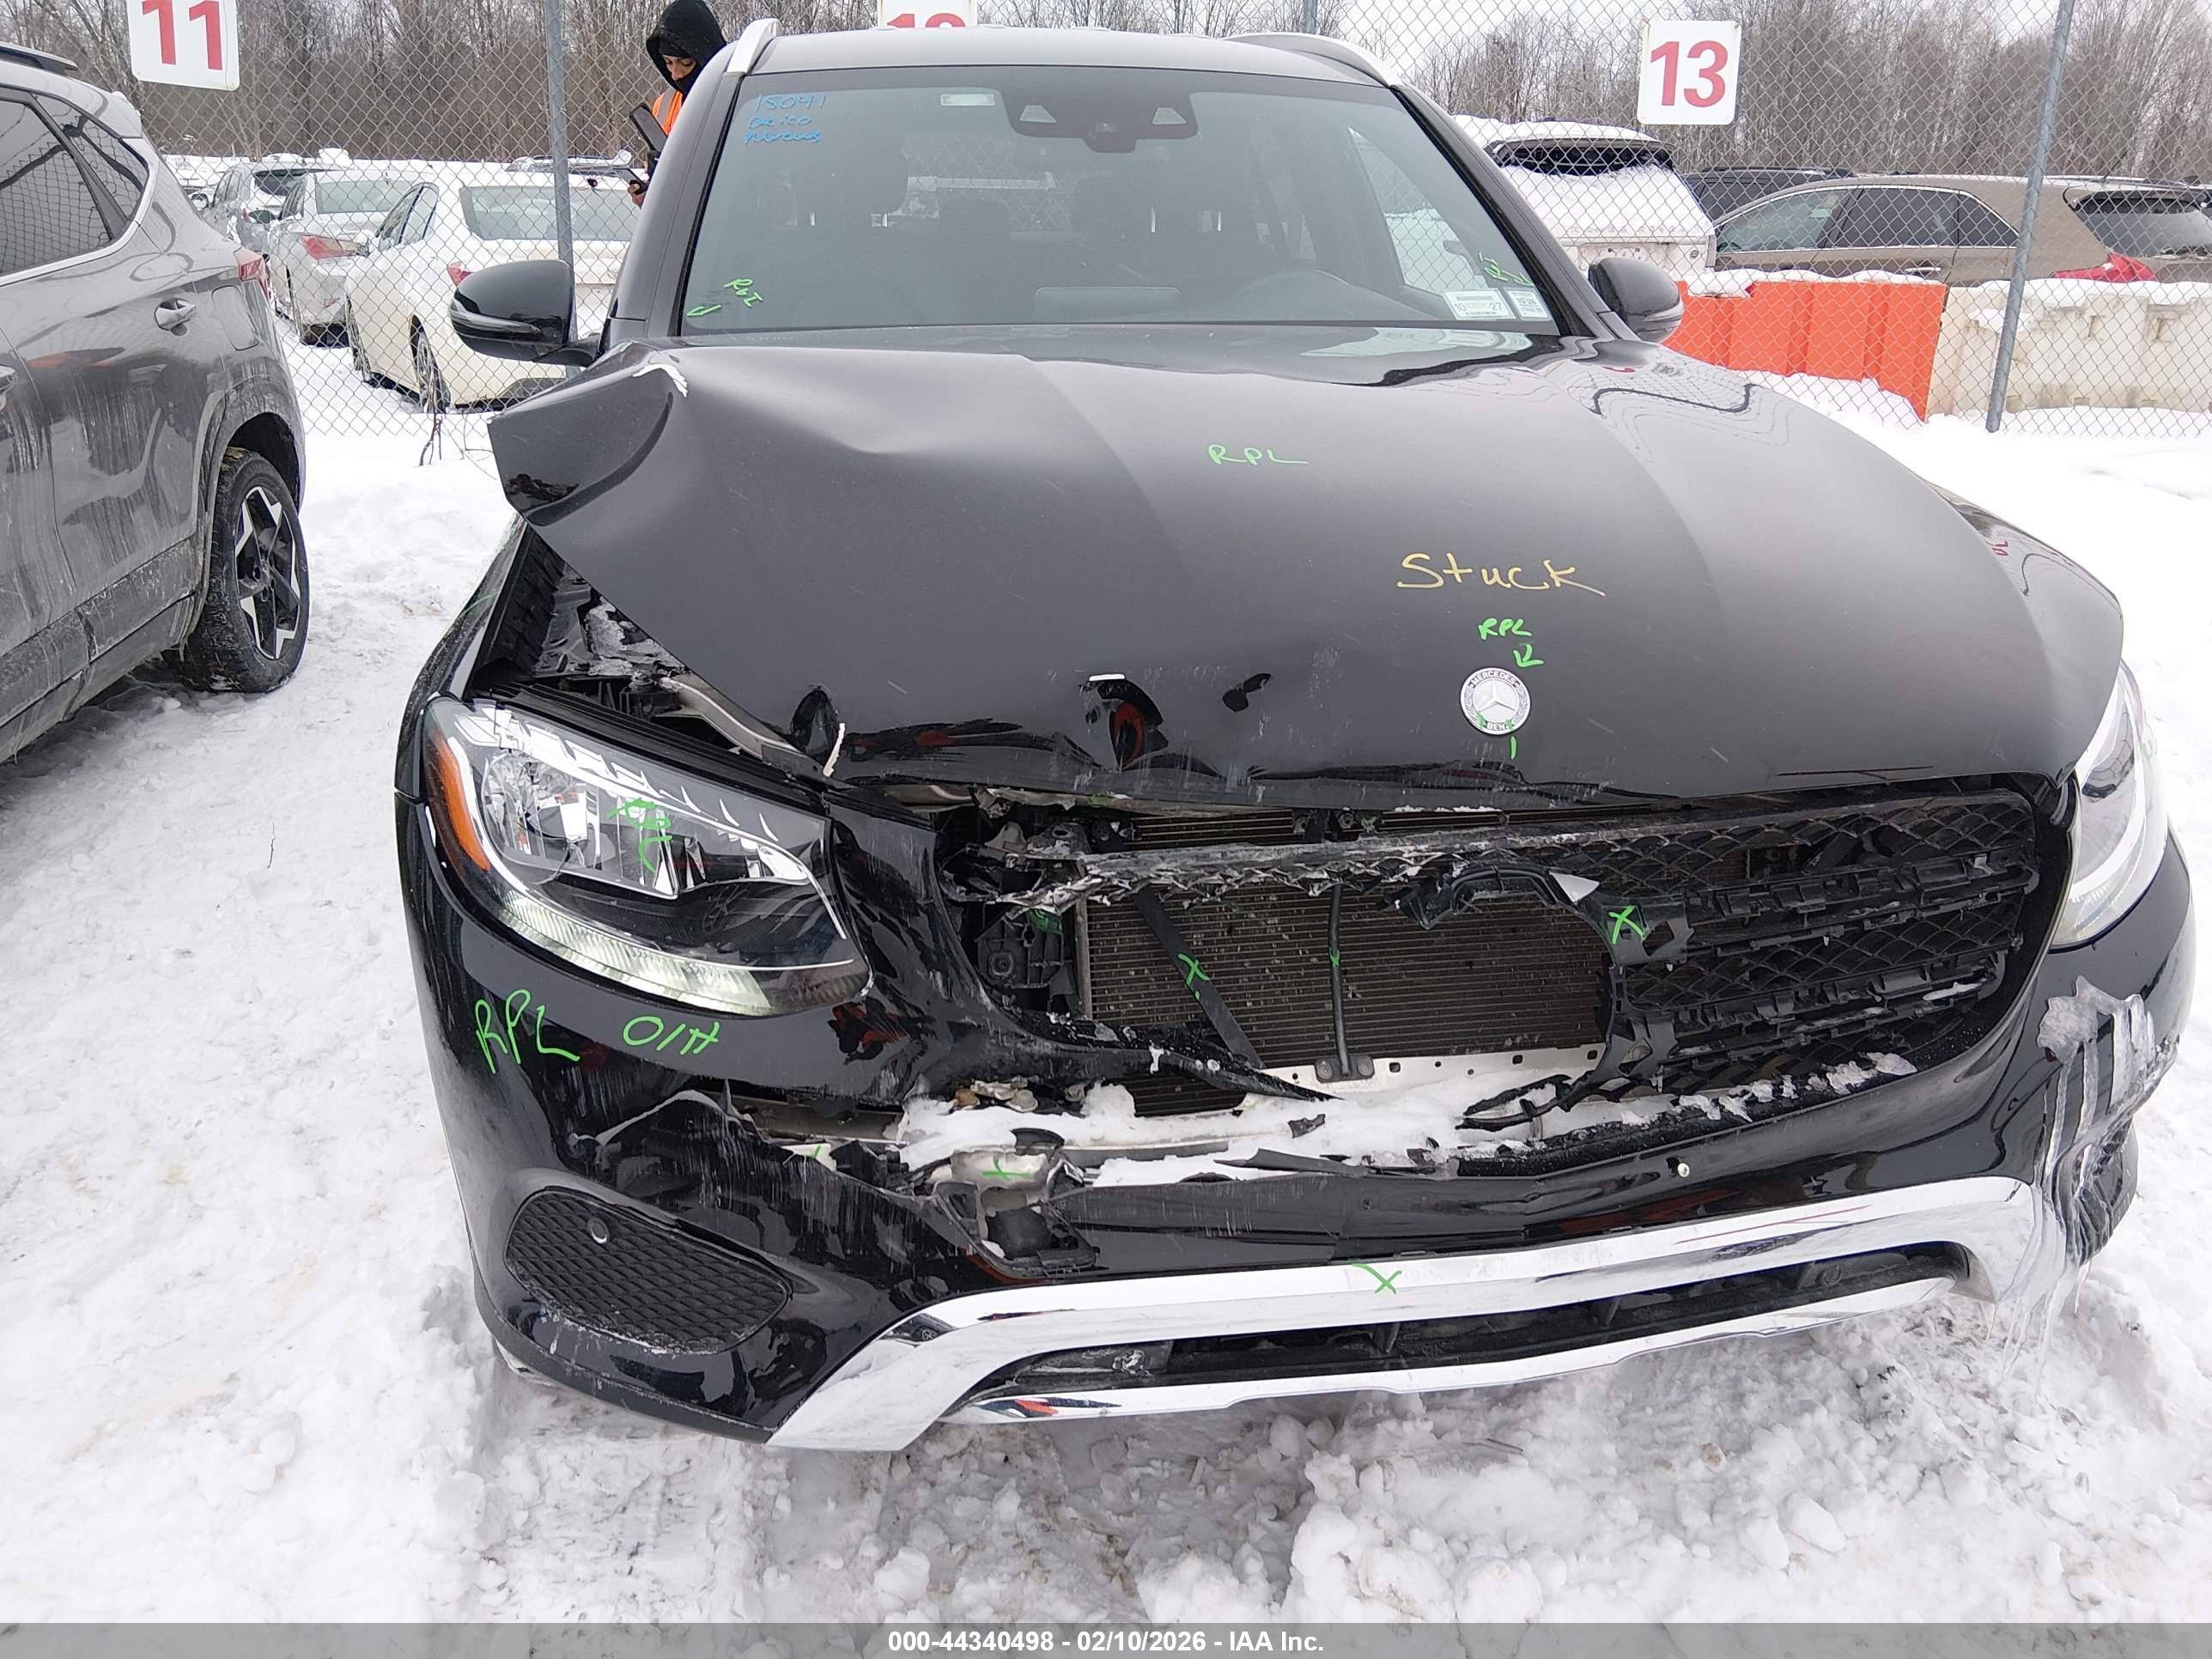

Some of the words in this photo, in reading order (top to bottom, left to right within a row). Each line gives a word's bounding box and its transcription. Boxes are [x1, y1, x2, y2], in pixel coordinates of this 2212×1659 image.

[142, 0, 222, 70] 11
[1650, 40, 1728, 107] 13
[1208, 444, 1310, 466] RPL
[1396, 552, 1606, 597] Stuck
[1477, 617, 1532, 641] RPL
[1472, 671, 1516, 685] MERCEDES
[475, 989, 580, 1073] RPL
